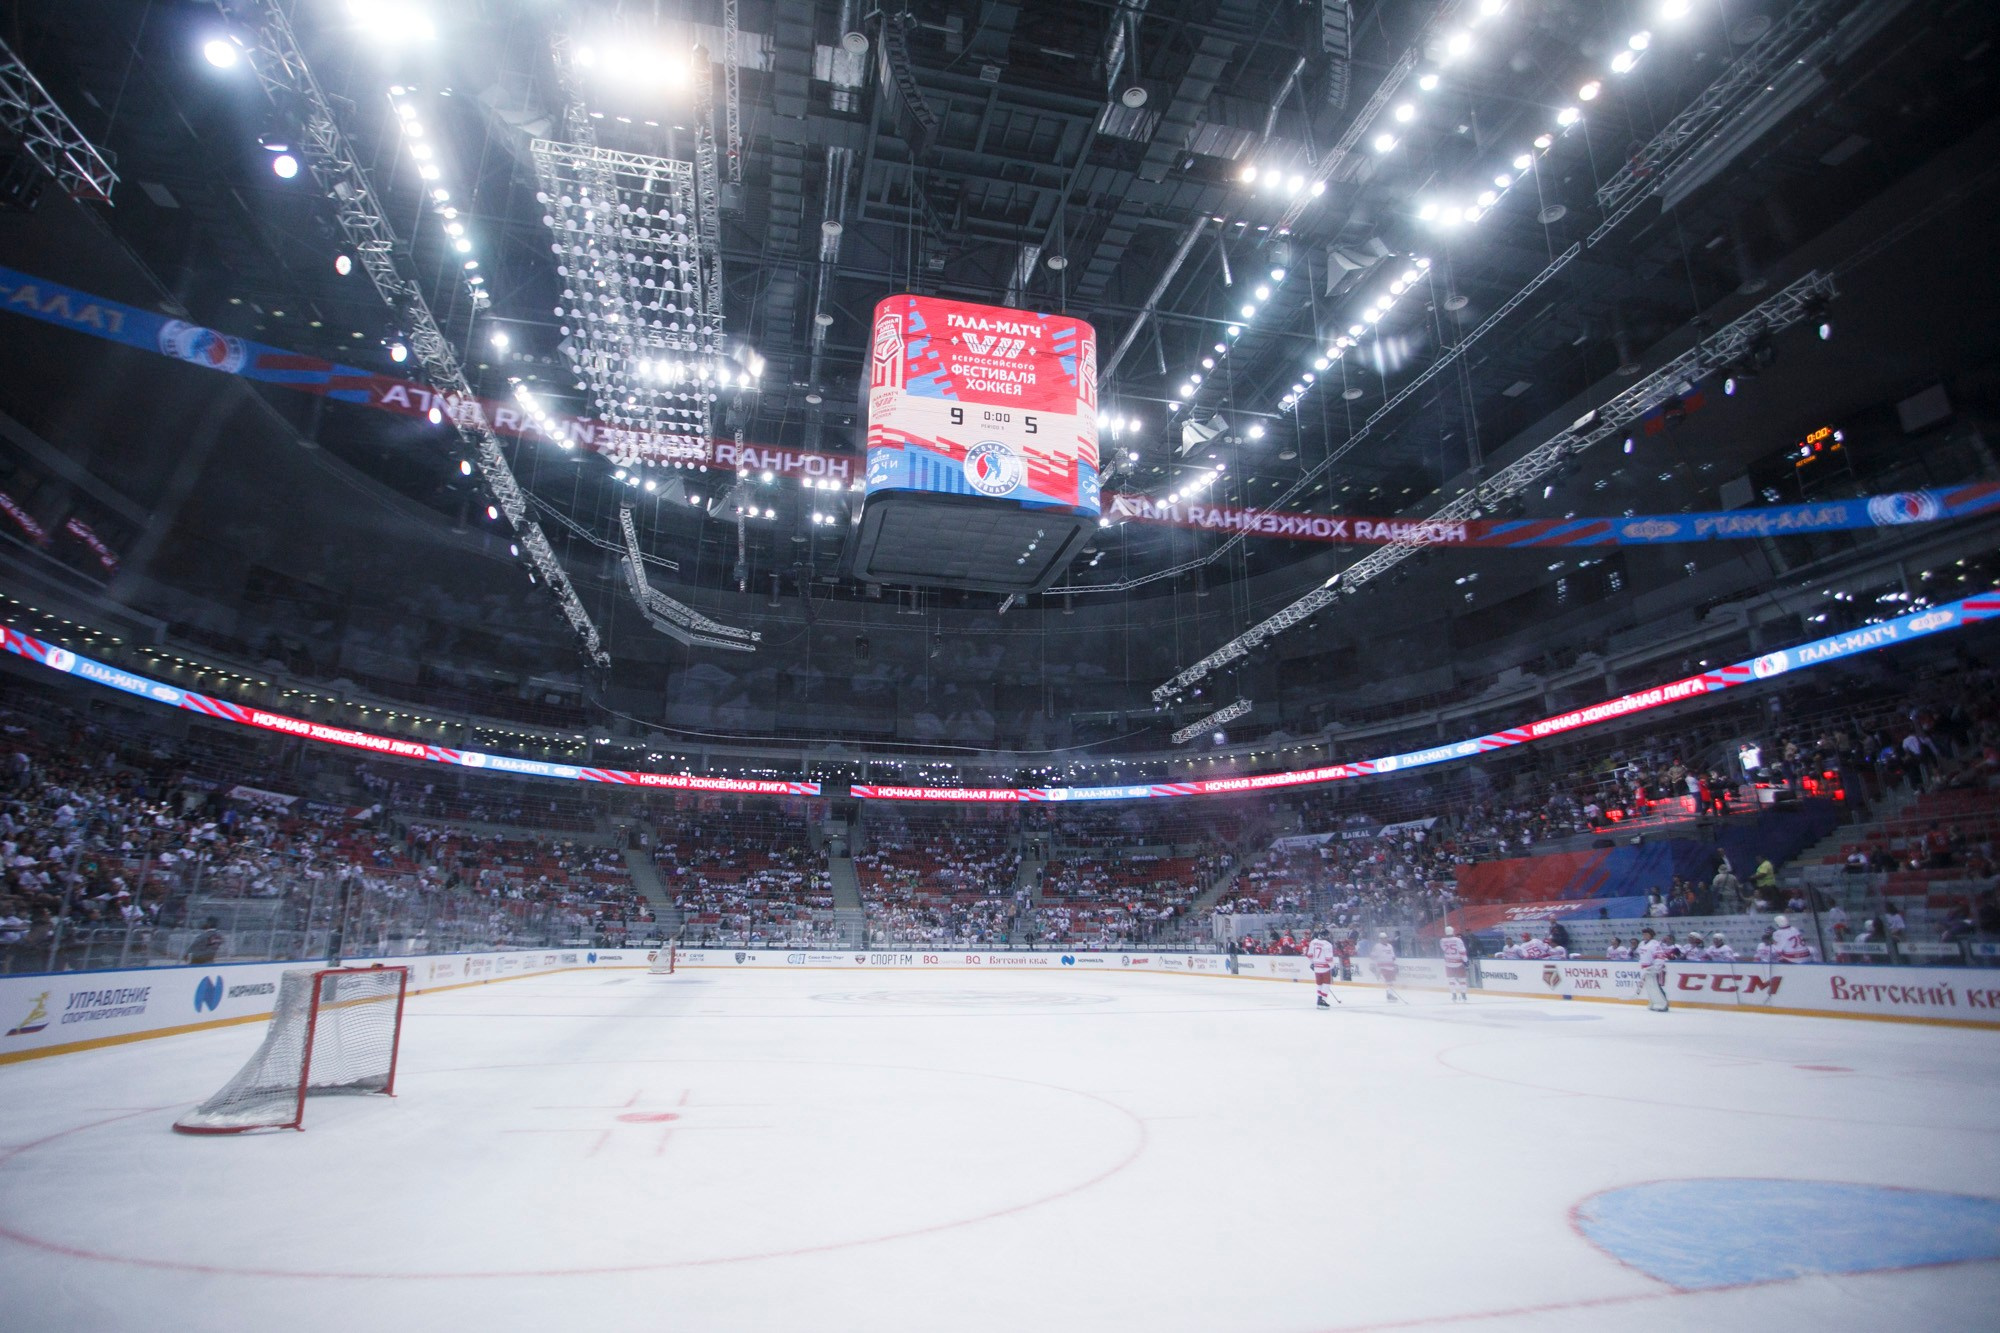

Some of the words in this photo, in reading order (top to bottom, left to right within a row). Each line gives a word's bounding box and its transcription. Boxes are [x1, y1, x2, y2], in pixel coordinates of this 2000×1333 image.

[947, 313, 1041, 338] ГАЛА-МАТЧ
[962, 332, 1026, 359] VII
[952, 354, 1035, 371] ВСЕРОССИЙСКОГО
[951, 363, 1036, 384] ФЕСТИВАЛЯ
[966, 378, 1022, 396] ХОККЕЯ
[951, 407, 964, 426] 9
[984, 411, 1010, 423] 0:00
[1025, 416, 1038, 434] 5
[1806, 427, 1828, 444] 0:00
[1833, 430, 1843, 442] 5
[1800, 445, 1810, 457] 9
[1799, 625, 1897, 662] ГАЛА-МАТЧ
[80, 663, 149, 693] ГАЛА-МАТЧ
[1532, 712, 1581, 735] НОЧНАЯ
[1582, 690, 1663, 722] ХОККЕЙНАЯ
[1663, 679, 1704, 700] ЛИГА
[252, 712, 310, 735] НОЧНАЯ
[310, 725, 390, 750] ХОККЕЙНАЯ
[391, 742, 426, 756] ЛИГА
[491, 758, 549, 774] ГАЛА-МАТЧ
[1402, 748, 1453, 767] ГАЛА-МАТЧ
[639, 774, 687, 787] НОЧНАЯ
[689, 778, 757, 791] ХОККЕЙНАЯ
[758, 782, 788, 793] ЛИГА
[1205, 779, 1250, 791] НОЧНАЯ
[1251, 772, 1316, 787] ХОККЕЙНАЯ
[1317, 767, 1346, 780] ЛИГА
[878, 788, 922, 798] НОЧНАЯ
[924, 788, 987, 799] ХОККЕЙНАЯ
[989, 790, 1017, 800] ЛИГА
[1074, 788, 1123, 798] ГАЛА-МАТЧ
[871, 954, 897, 965] СПОРТ
[900, 955, 913, 965] FM
[923, 955, 939, 965] BQ
[965, 955, 981, 965] BQ
[1481, 971, 1518, 981] ОРНИКЕЛЬ
[1565, 968, 1608, 979] НОЧНАЯ
[1575, 979, 1601, 990] ЛИГА
[1677, 972, 1783, 995] CCM
[1829, 975, 1957, 1007] Вятский
[65, 986, 152, 1011] УПРАВЛЕНИЕ
